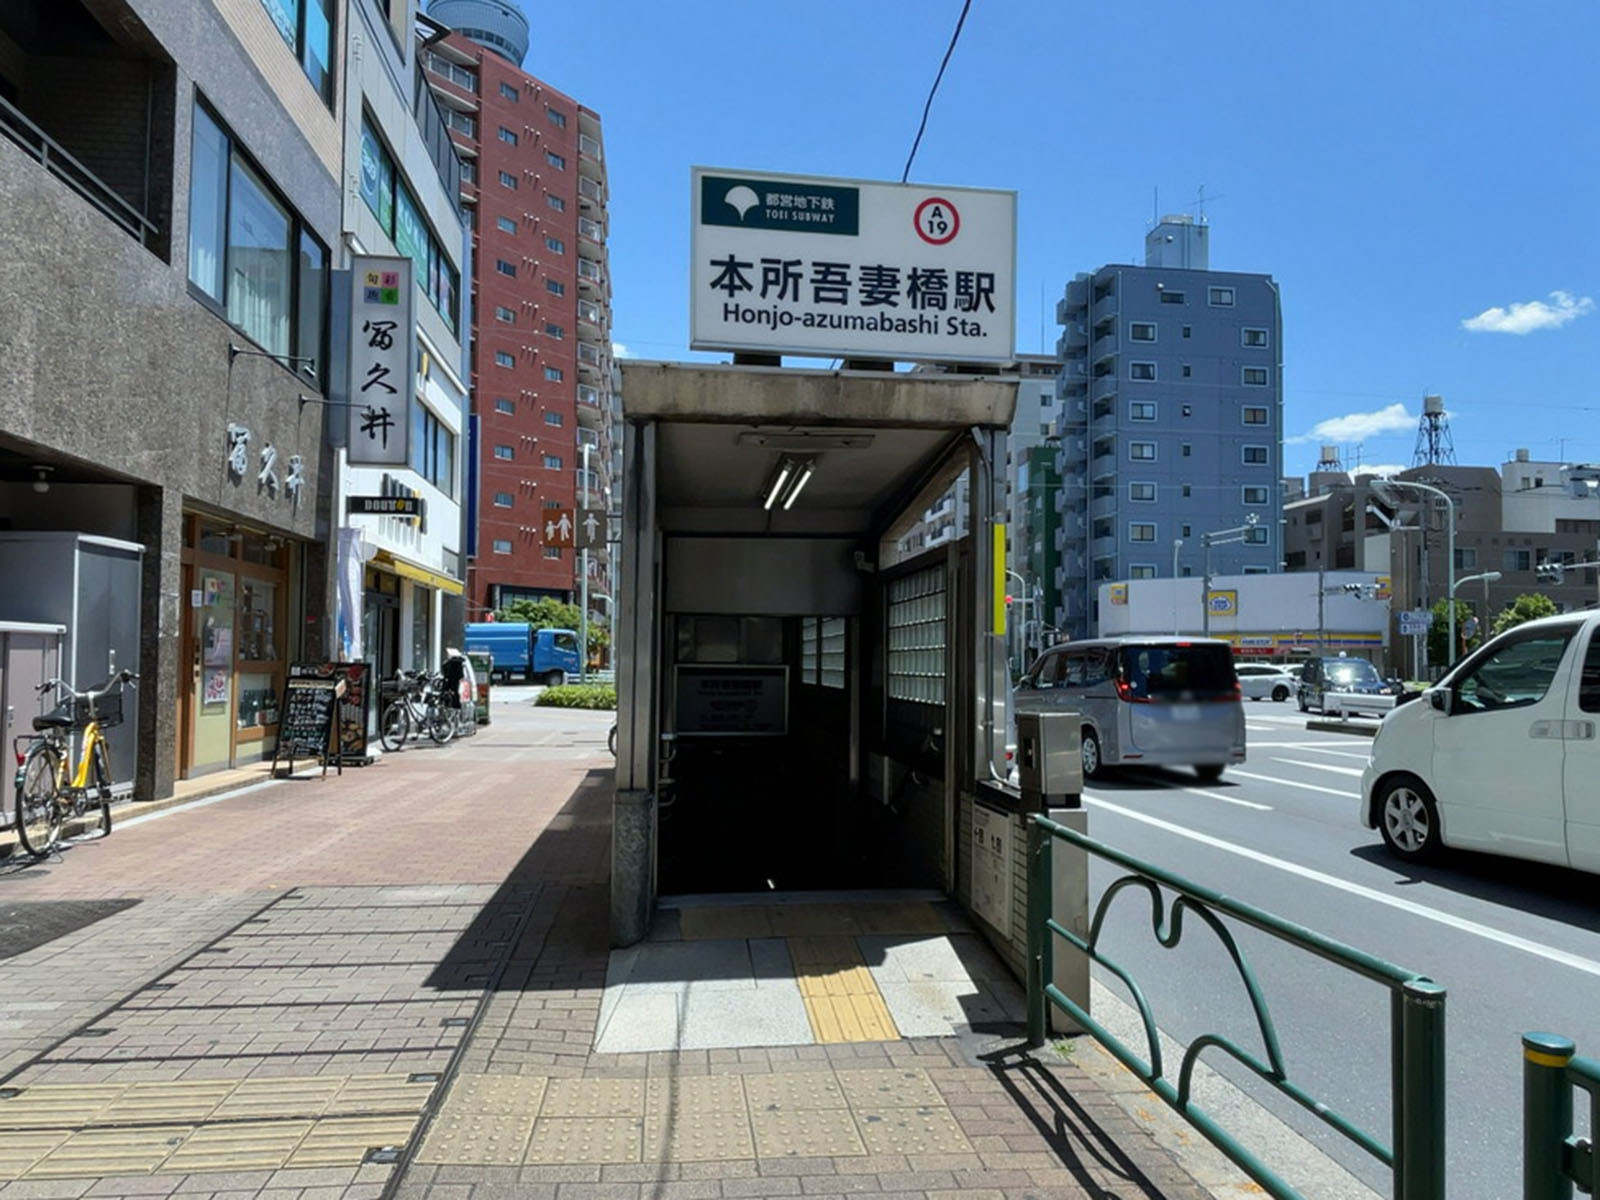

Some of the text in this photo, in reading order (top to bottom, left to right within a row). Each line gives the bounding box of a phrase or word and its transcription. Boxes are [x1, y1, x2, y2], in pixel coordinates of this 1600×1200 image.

[766, 193, 834, 210] 都営地下鉄
[766, 208, 834, 223] TOEI SUBWAY
[931, 205, 943, 219] A
[928, 220, 948, 235] 19
[709, 254, 996, 313] 本所吾妻橋駅
[723, 302, 988, 337] Honjo-azumabashi Sta.
